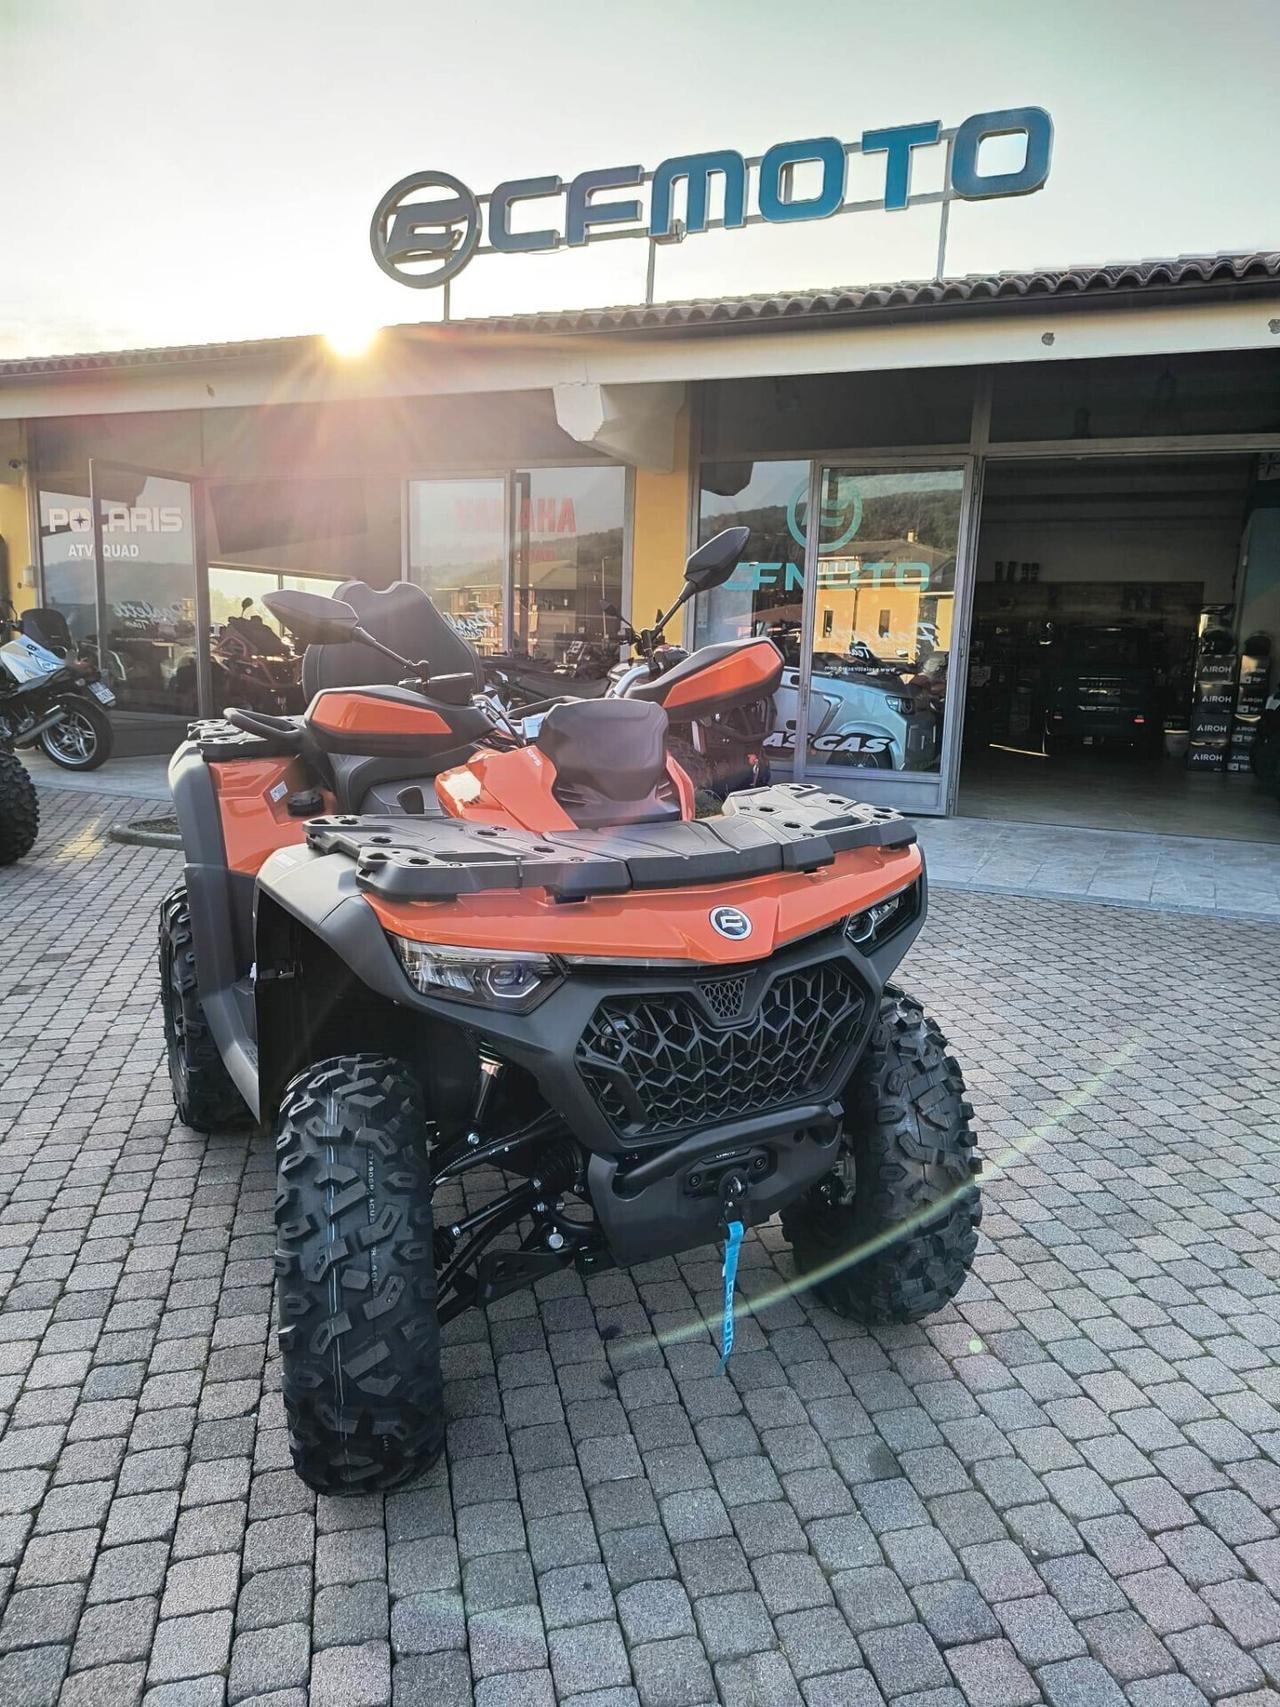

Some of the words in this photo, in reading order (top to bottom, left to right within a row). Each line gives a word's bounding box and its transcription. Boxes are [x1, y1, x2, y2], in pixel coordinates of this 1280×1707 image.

[488, 105, 1055, 252] CFMOTO
[48, 507, 183, 533] POARIS
[67, 544, 94, 557] ATV
[103, 544, 139, 558] QUAD
[1202, 664, 1232, 674] AIROH
[1201, 695, 1232, 704] AIROH
[1196, 723, 1227, 733] AIROH
[1193, 752, 1223, 762] AIROH
